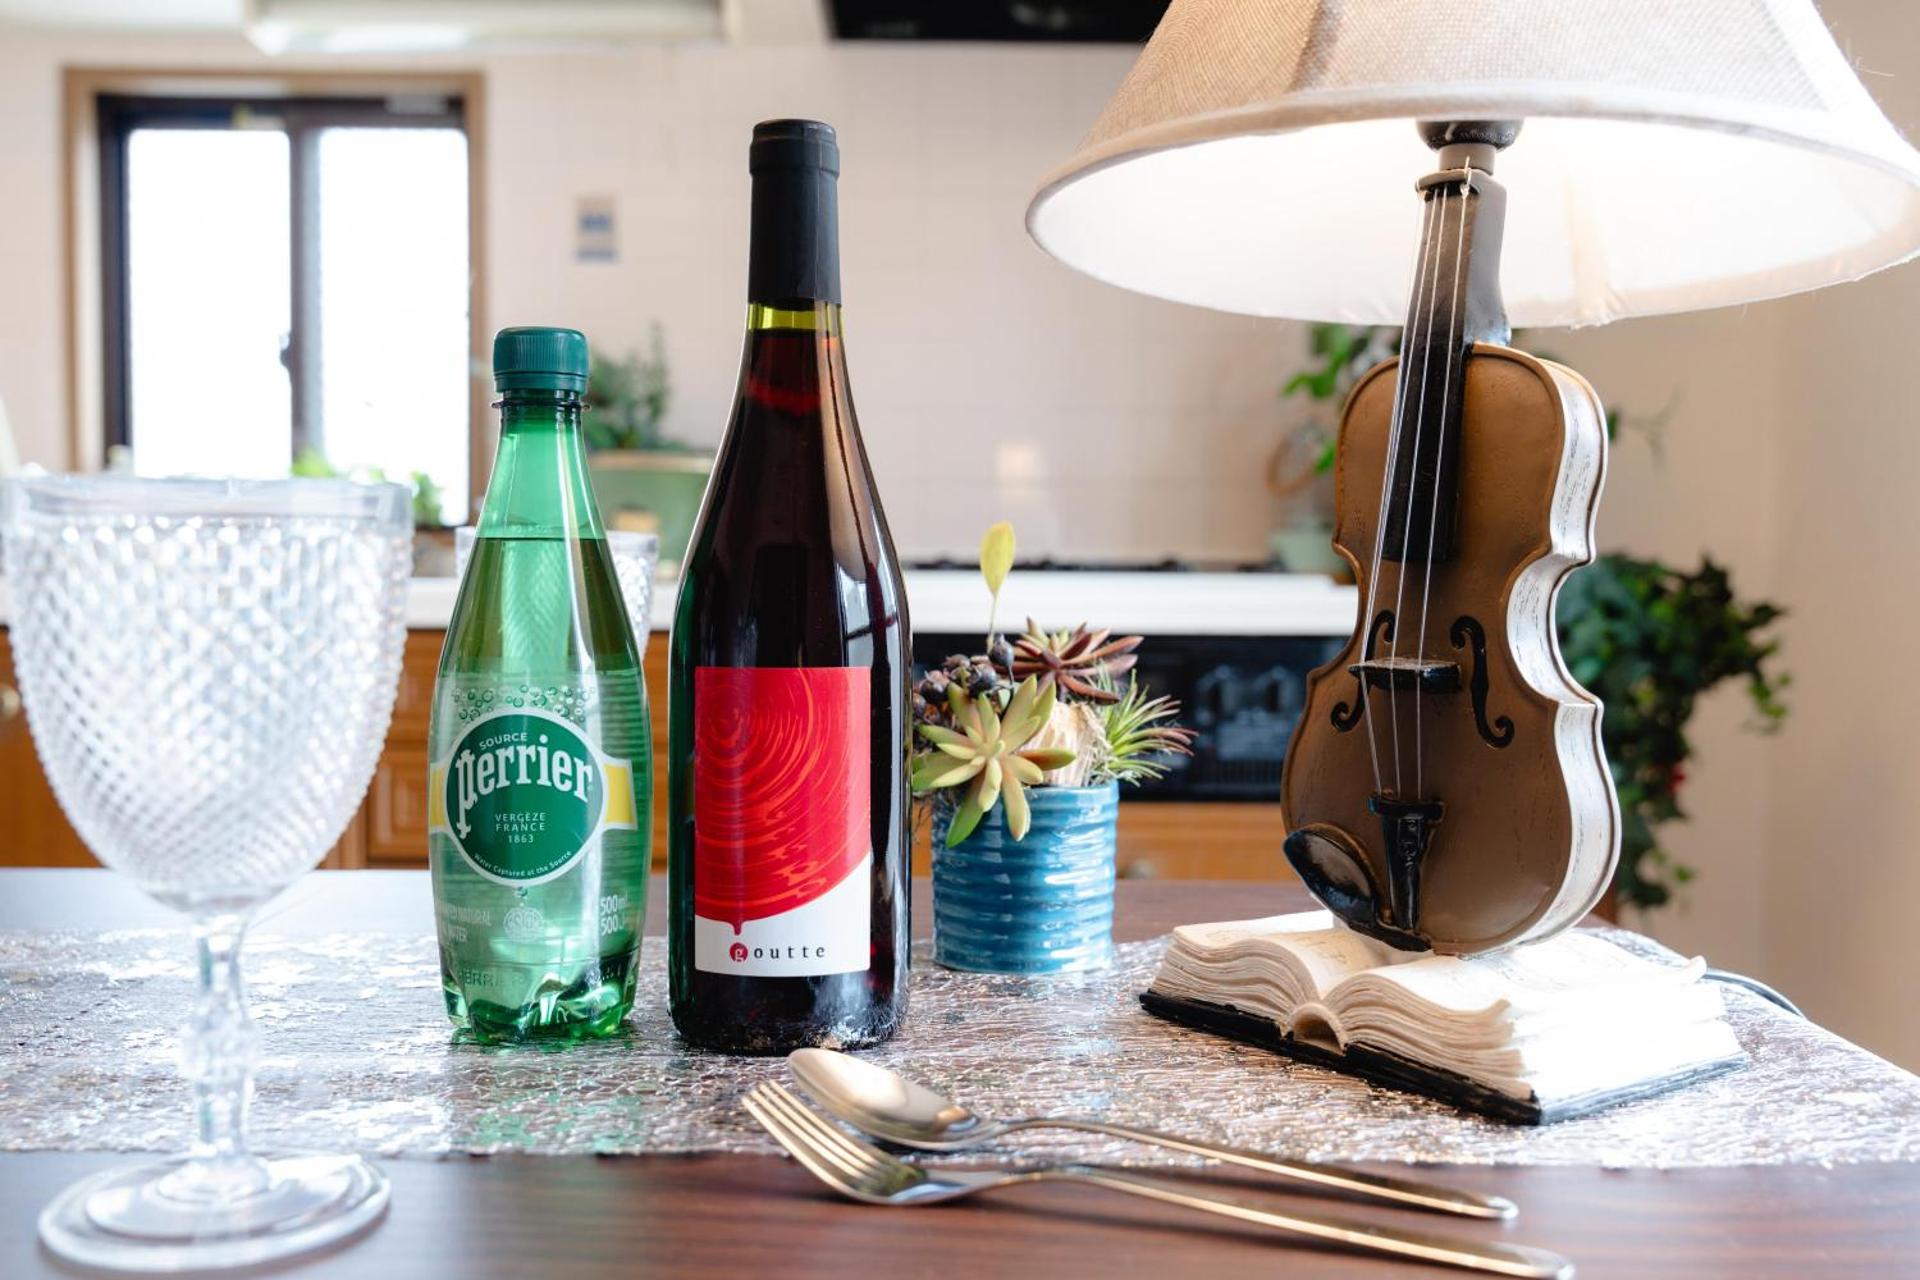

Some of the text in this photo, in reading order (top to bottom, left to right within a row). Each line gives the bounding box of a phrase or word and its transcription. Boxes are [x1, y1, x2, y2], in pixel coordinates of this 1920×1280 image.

[479, 732, 528, 750] SOURCE
[495, 822, 546, 832] FRANCE
[507, 833, 534, 843] 1863
[549, 850, 572, 868] Source
[730, 943, 826, 962] goutte
